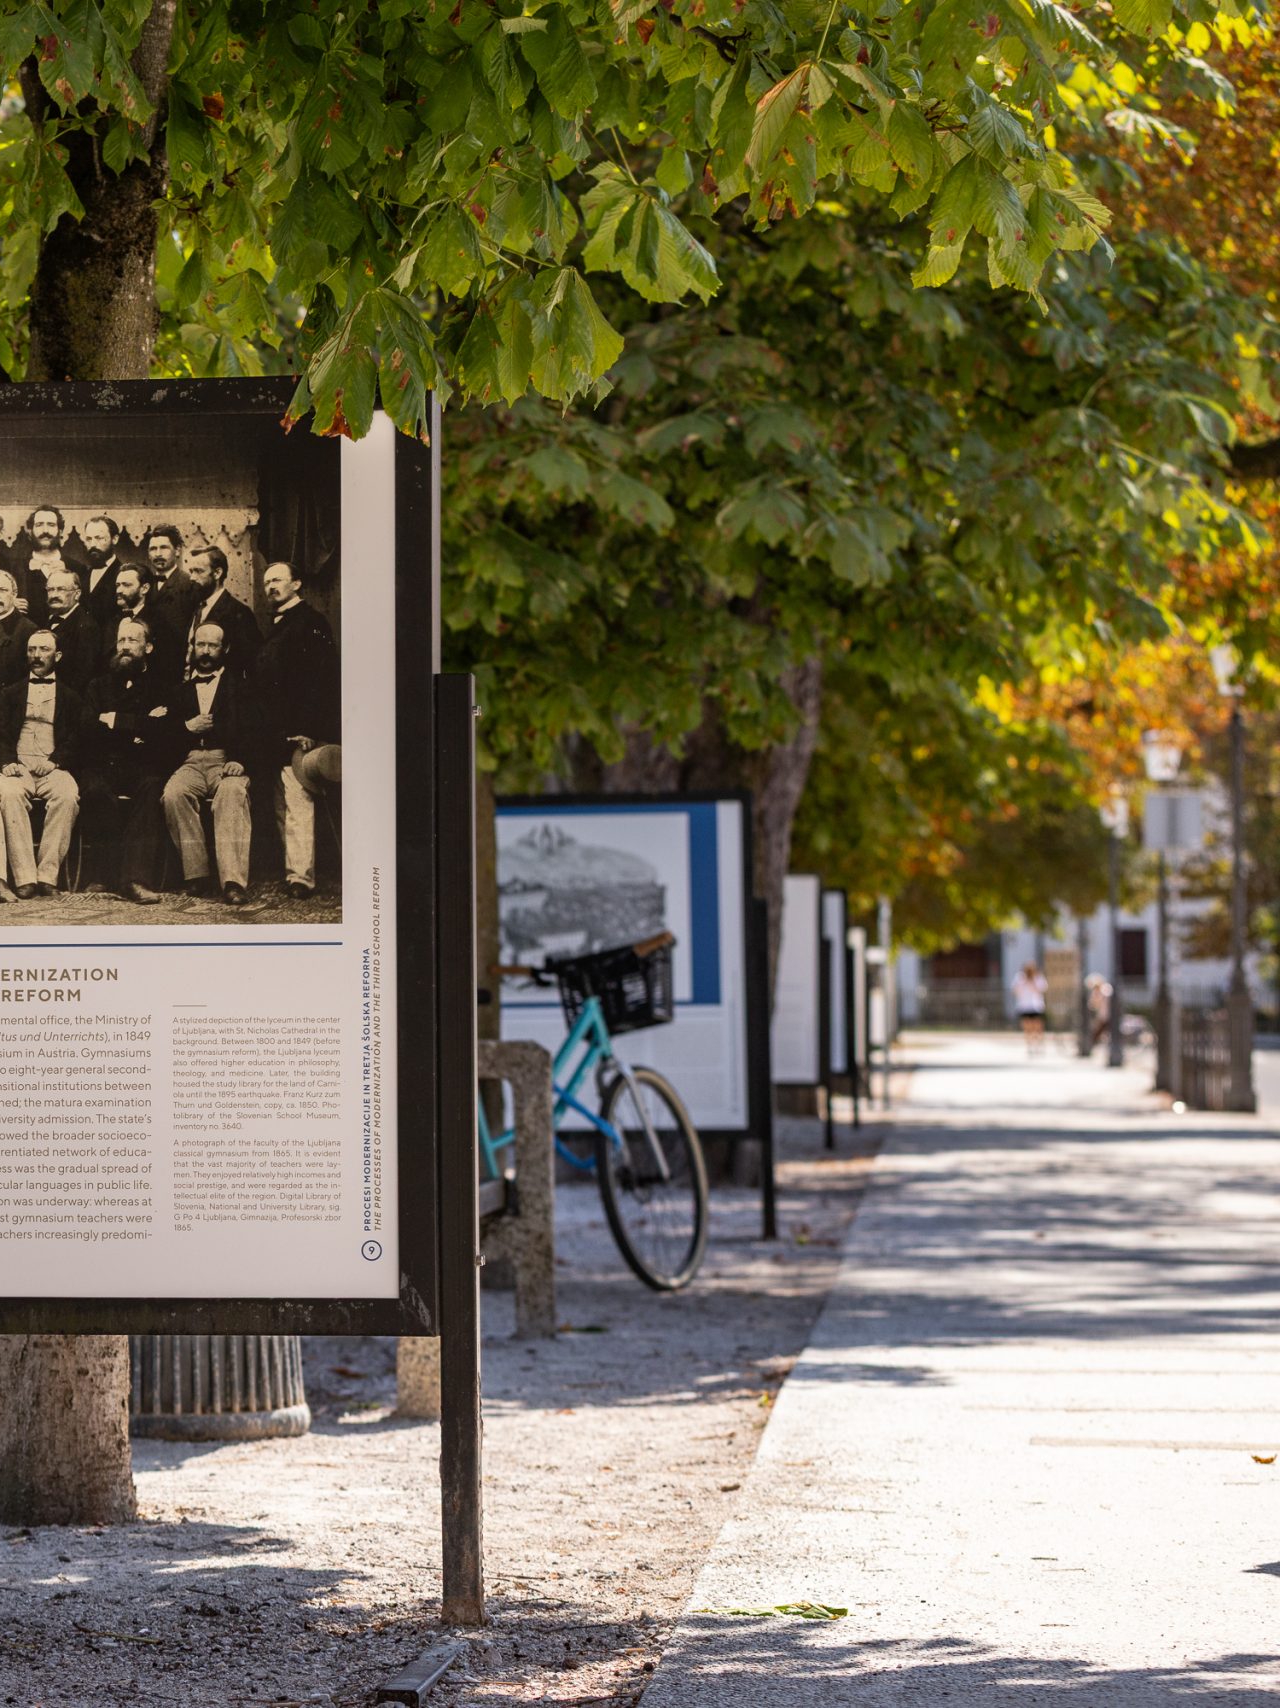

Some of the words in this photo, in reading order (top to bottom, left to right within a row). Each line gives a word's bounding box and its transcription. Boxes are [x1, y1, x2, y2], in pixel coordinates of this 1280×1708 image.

[372, 867, 380, 910] REFORM
[372, 913, 381, 956] SCHOOL
[363, 948, 371, 998] REFORMA
[373, 959, 381, 990] THIRD
[1, 988, 81, 1002] REFORM
[373, 992, 381, 1013] THE
[39, 1014, 72, 1026] office,
[75, 1015, 93, 1024] the
[95, 1015, 138, 1027] Ministry
[140, 1014, 152, 1024] of
[361, 1001, 371, 1041] ŠOLSKA
[373, 1016, 381, 1038] AND
[19, 1031, 41, 1041] und
[43, 1031, 110, 1043] Unterrichts),
[113, 1031, 123, 1040] in
[125, 1030, 153, 1041] 1849
[25, 1048, 35, 1057] in
[37, 1047, 79, 1058] Austria.
[80, 1047, 152, 1060] Gymnasiums
[363, 1044, 371, 1081] TRETJA
[363, 1083, 371, 1096] IN
[373, 1041, 381, 1129] MODERNIZATION
[173, 1112, 203, 1120] tolibrary
[207, 1111, 215, 1119] of
[236, 1111, 272, 1119] Slovenian
[276, 1111, 302, 1119] School
[31, 1130, 49, 1140] the
[52, 1130, 95, 1140] broader
[97, 1130, 152, 1140] socioeco-
[181, 1139, 225, 1148] photograph
[253, 1138, 279, 1148] faculty
[307, 1138, 341, 1147] Ljubljana
[363, 1098, 371, 1184] MODERNIZACIJE
[373, 1130, 381, 1146] OF
[173, 1149, 203, 1157] classical
[251, 1149, 269, 1157] from
[295, 1149, 301, 1157] It
[373, 1148, 381, 1209] PROCESSES
[373, 1210, 382, 1231] THE
[368, 1246, 375, 1255] 9
